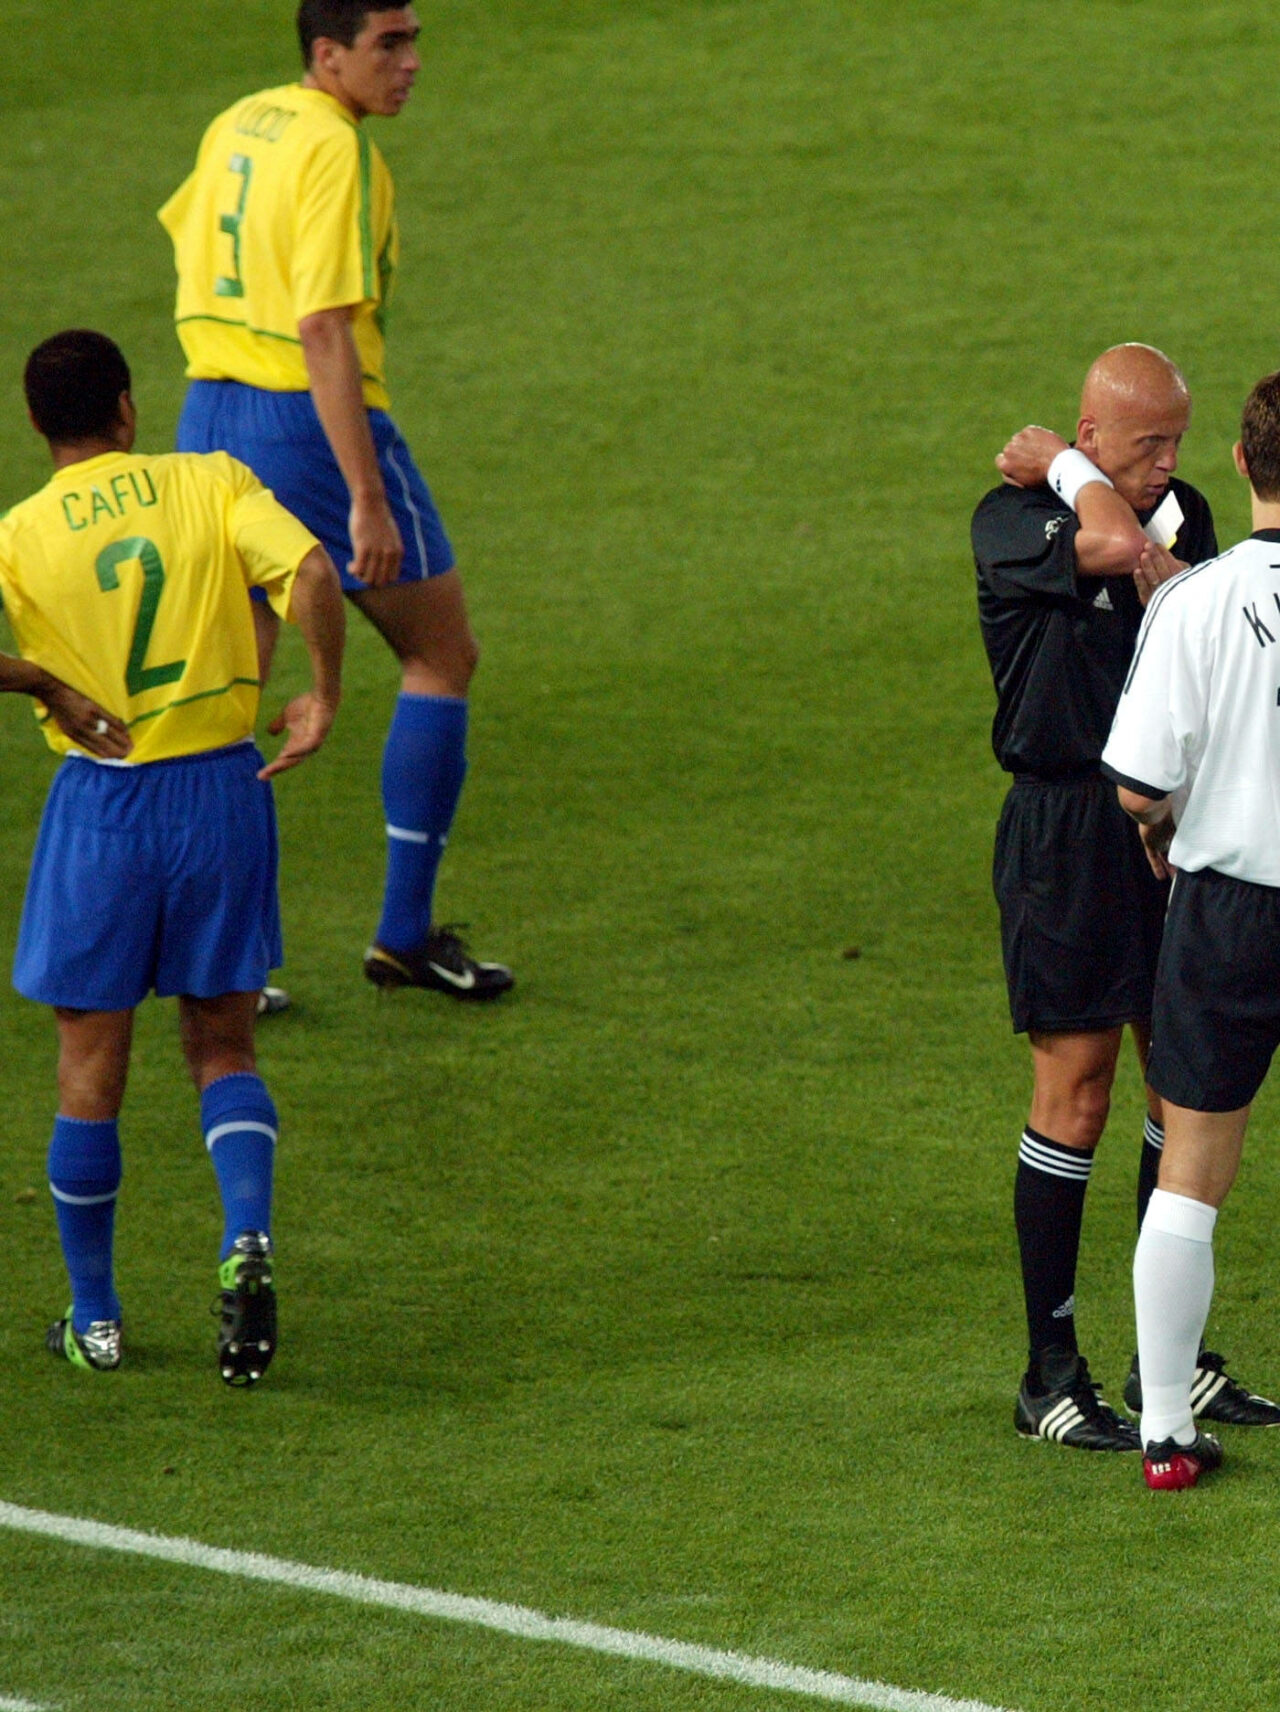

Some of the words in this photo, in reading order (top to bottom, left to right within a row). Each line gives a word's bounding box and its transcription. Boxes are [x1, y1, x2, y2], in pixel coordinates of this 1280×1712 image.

[214, 154, 252, 296] 3
[62, 469, 158, 531] CAFU
[95, 536, 187, 697] 2
